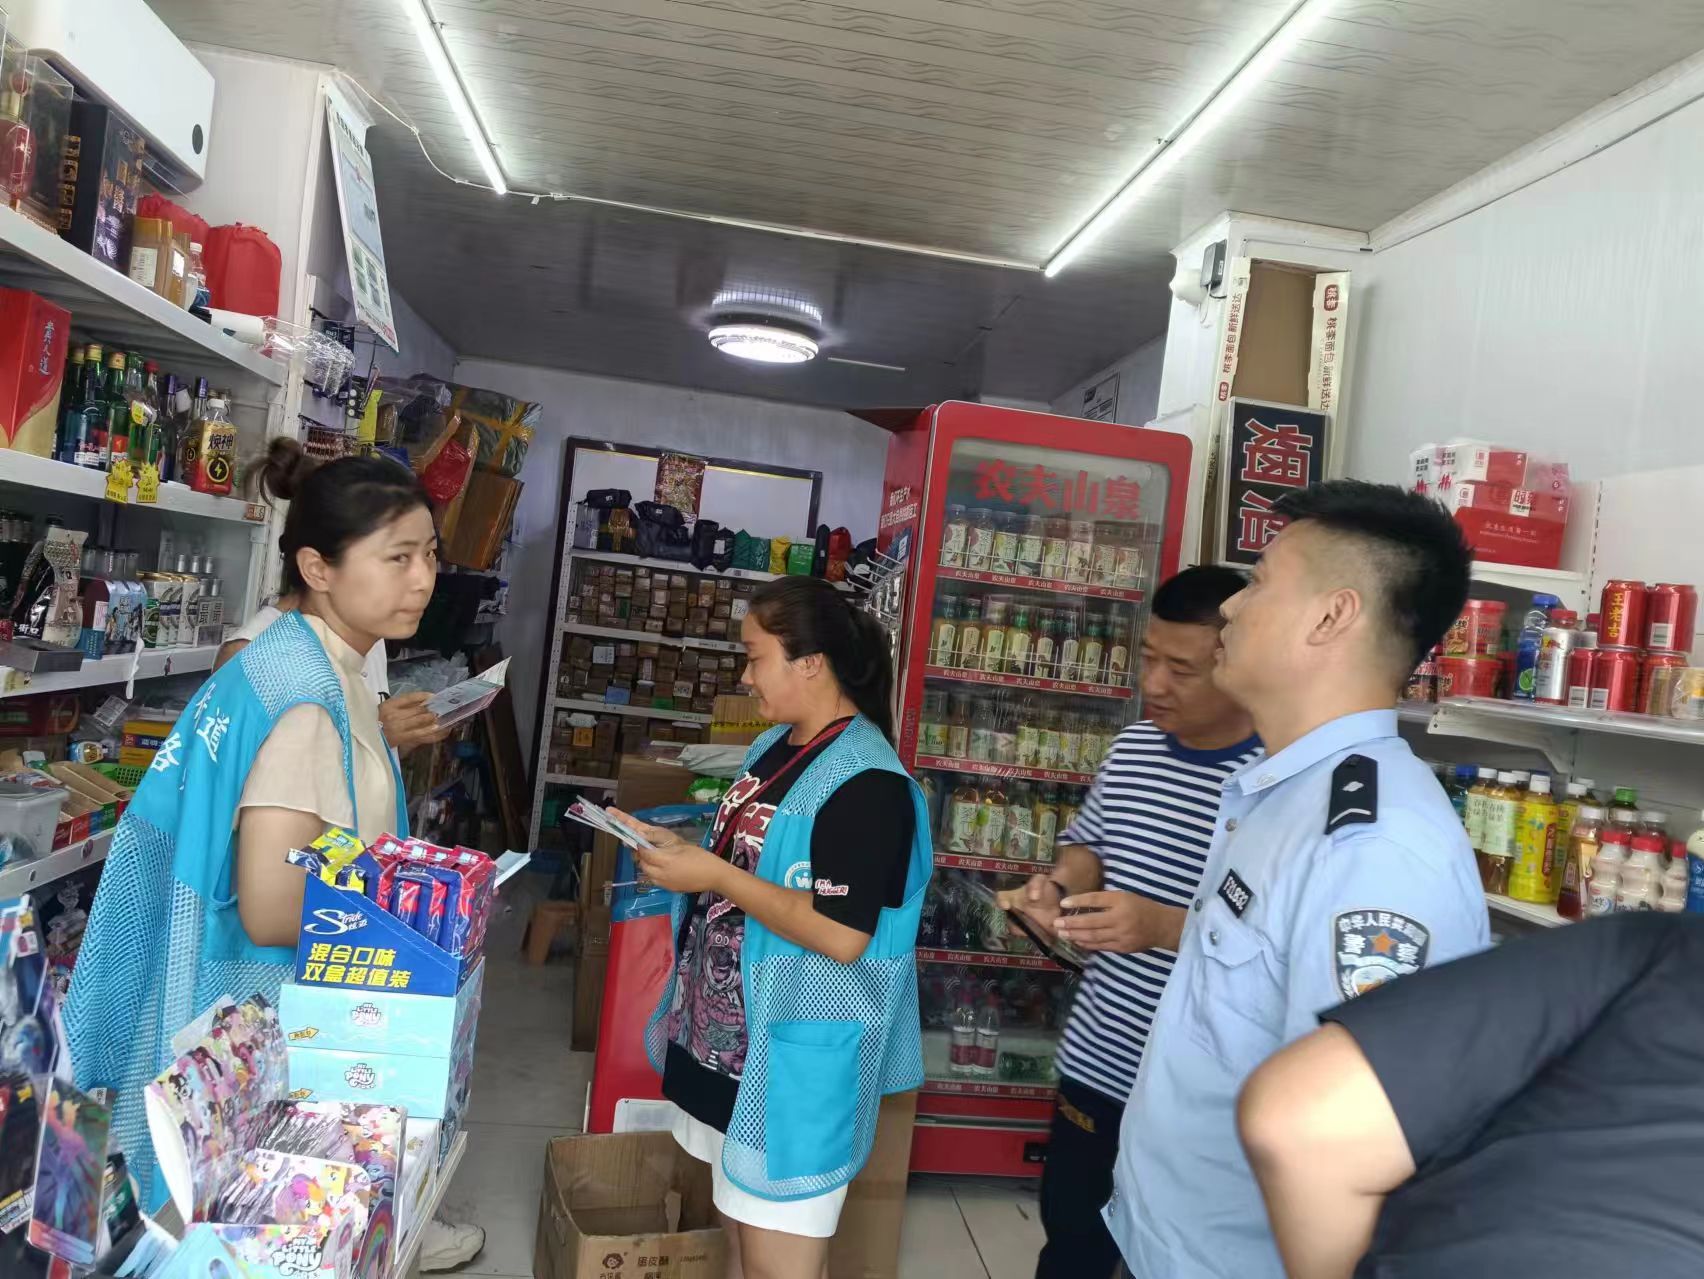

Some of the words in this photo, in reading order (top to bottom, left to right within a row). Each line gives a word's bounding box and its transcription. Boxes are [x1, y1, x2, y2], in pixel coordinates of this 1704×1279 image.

[1323, 317, 1338, 364] 桃李面包
[1223, 335, 1237, 374] 桃李面包
[975, 458, 1141, 520] 农夫山泉
[1607, 592, 1623, 639] 王老吉
[304, 908, 364, 935] Stride
[308, 942, 397, 967] 混合口味
[302, 962, 412, 988] 双盒超值装
[344, 1071, 376, 1088] PONY
[272, 1251, 323, 1276] PONY
